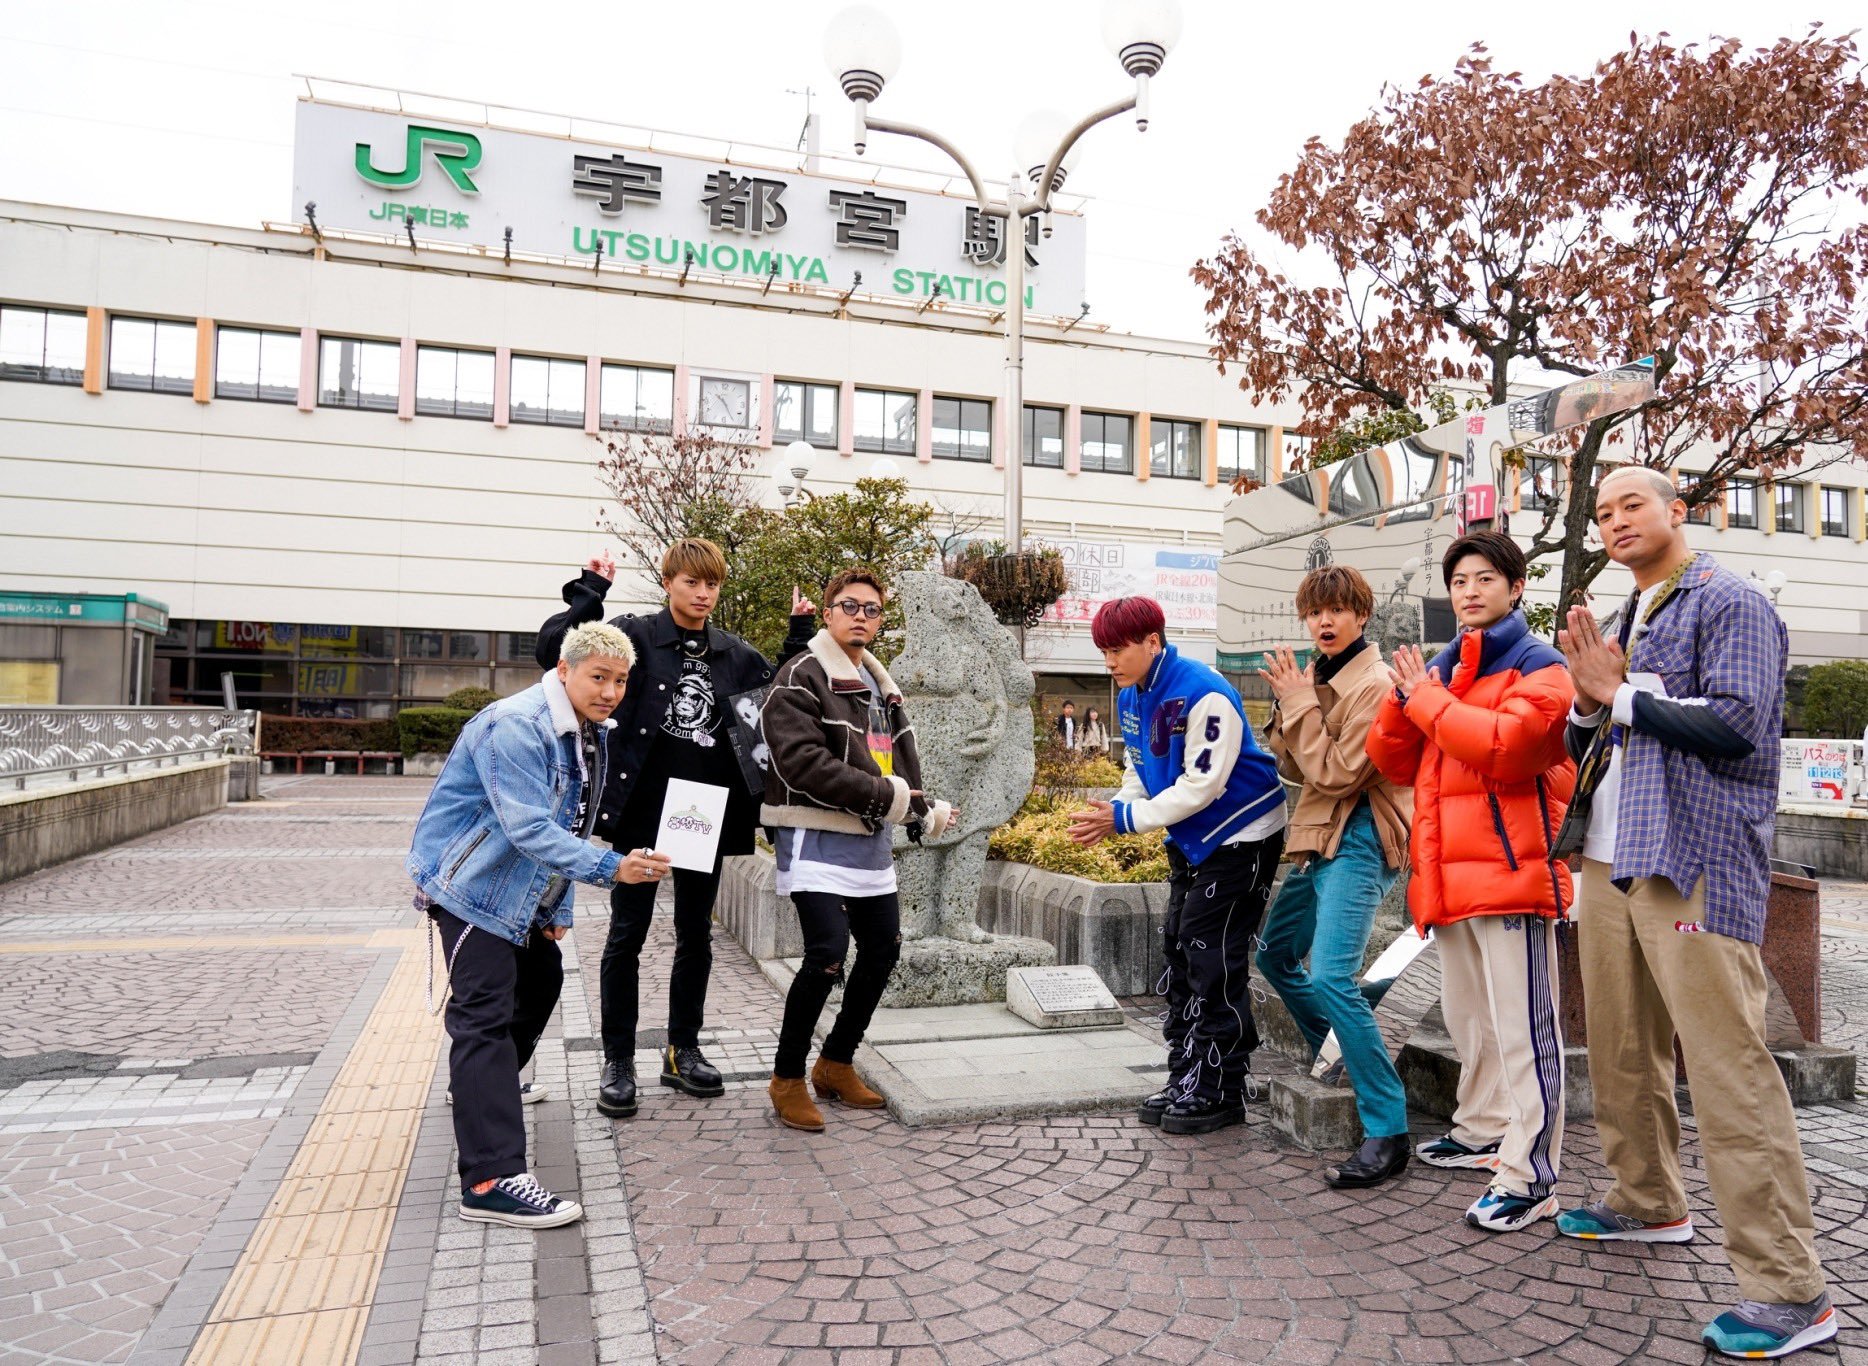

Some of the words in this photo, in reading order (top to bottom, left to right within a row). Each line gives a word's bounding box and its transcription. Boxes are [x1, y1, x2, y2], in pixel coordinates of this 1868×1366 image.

[355, 124, 483, 195] JR
[369, 201, 470, 230] JR東日本
[573, 153, 1040, 271] 宇都宮駅
[573, 227, 829, 283] UTSUNOMIYA
[893, 267, 1034, 309] STATION
[663, 721, 691, 738] From
[1204, 715, 1221, 742] 5
[1194, 747, 1212, 774] 4
